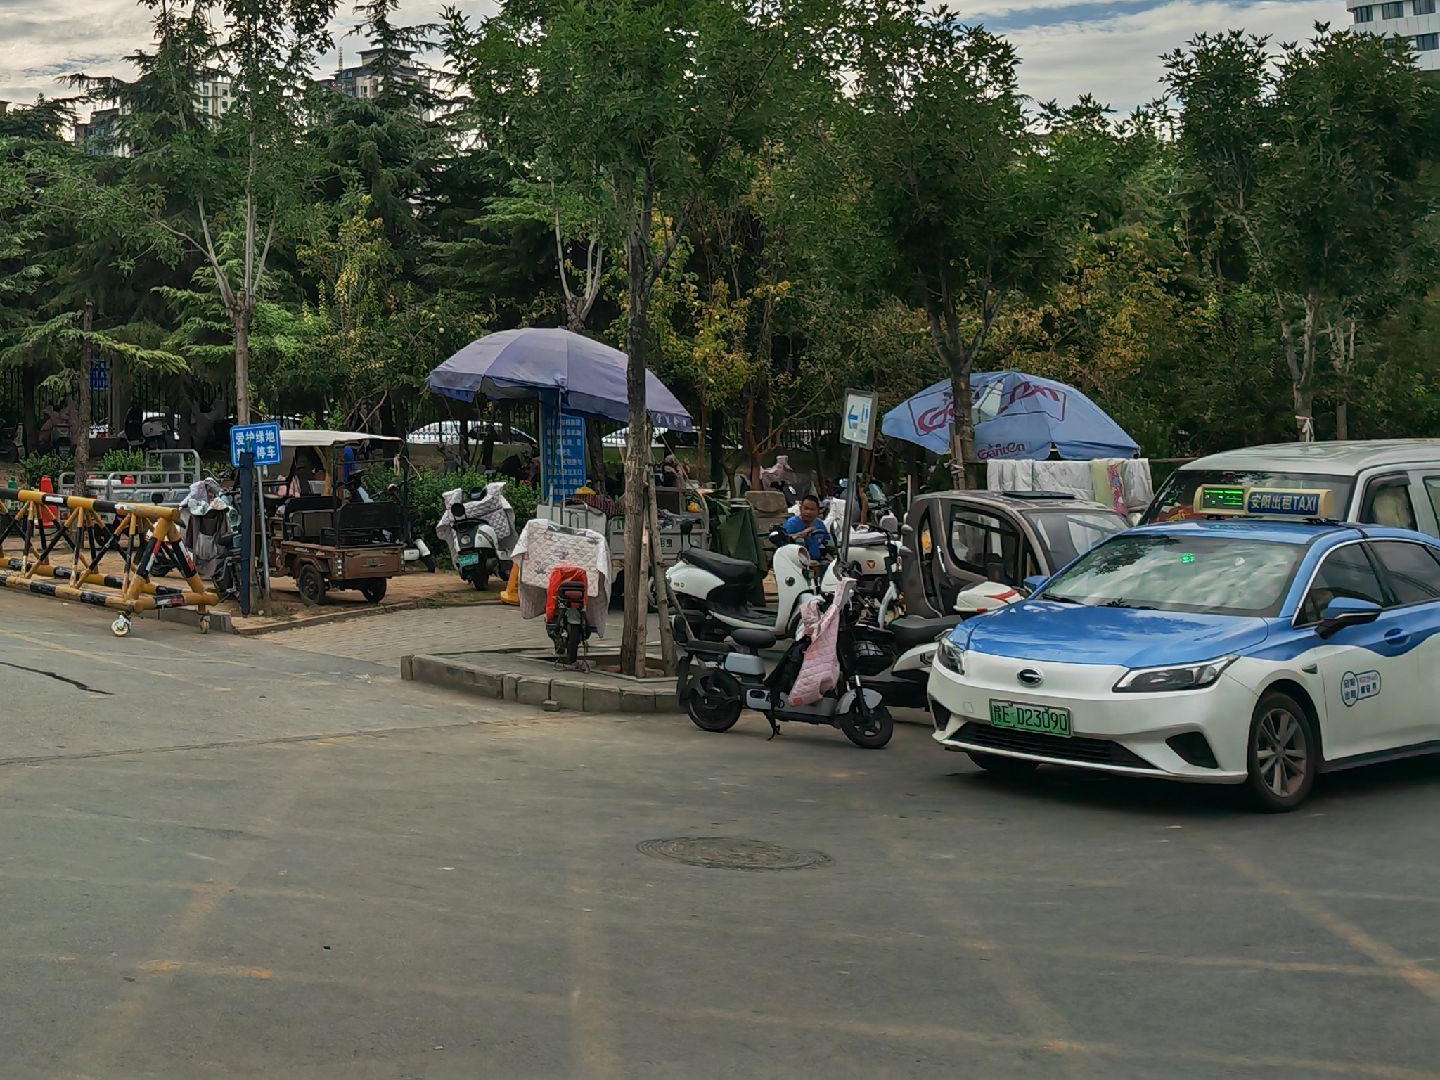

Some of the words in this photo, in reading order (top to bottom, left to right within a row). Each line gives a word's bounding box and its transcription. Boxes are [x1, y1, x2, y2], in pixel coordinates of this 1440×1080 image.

[235, 430, 276, 445] 爱护绿地
[236, 446, 277, 460] 停车
